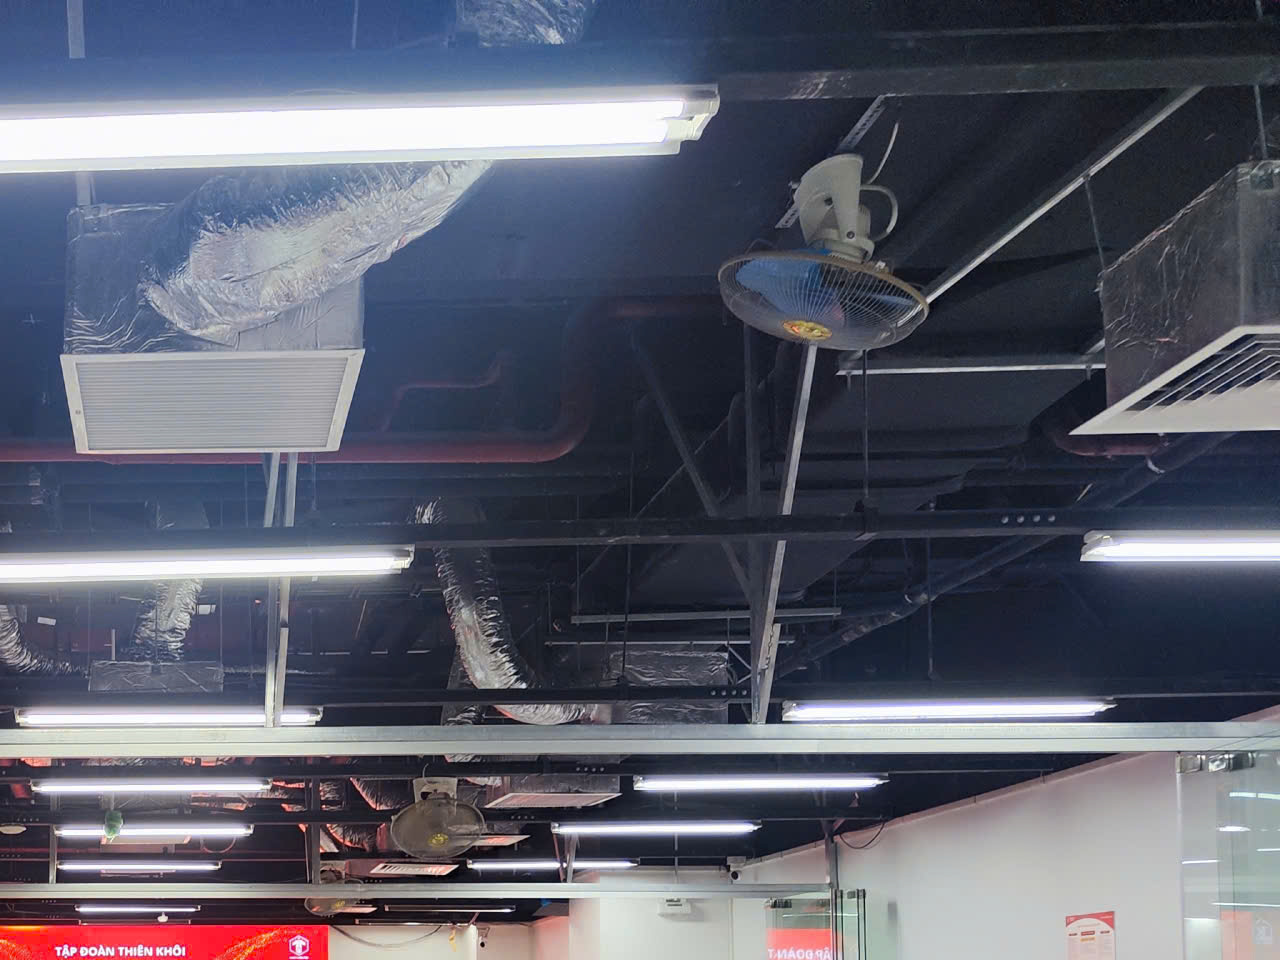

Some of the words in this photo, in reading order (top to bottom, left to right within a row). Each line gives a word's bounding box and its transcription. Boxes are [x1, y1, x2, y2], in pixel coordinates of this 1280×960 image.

[55, 944, 77, 959] TẬP
[79, 944, 115, 957] ĐOÀN
[118, 944, 153, 957] THIÊN
[156, 944, 186, 957] KHÔI
